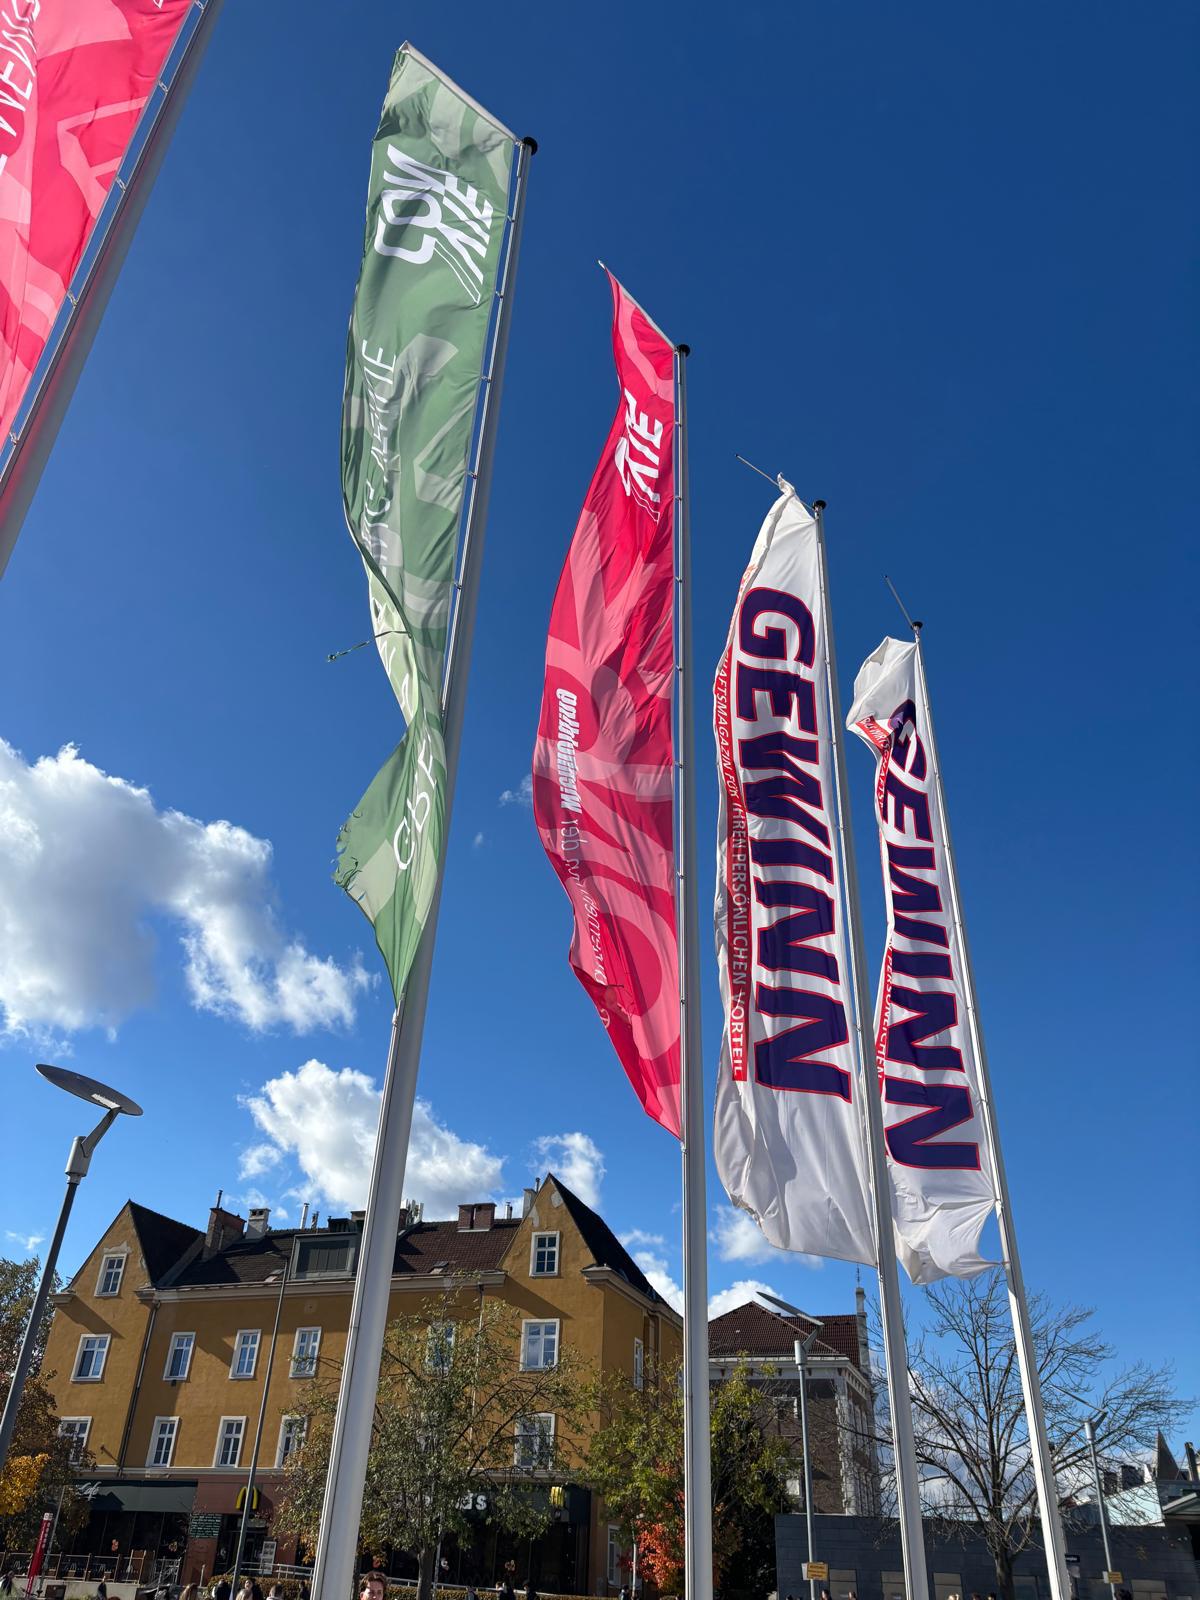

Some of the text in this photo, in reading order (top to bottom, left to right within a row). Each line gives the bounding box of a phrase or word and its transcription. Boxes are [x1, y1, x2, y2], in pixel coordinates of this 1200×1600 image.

[731, 802, 747, 848] IHREN
[735, 586, 853, 1104] GEWINN
[731, 853, 751, 986] PERSÖNLICHEN
[882, 699, 982, 1171] GEWINN
[731, 993, 747, 1076] VORTEIL
